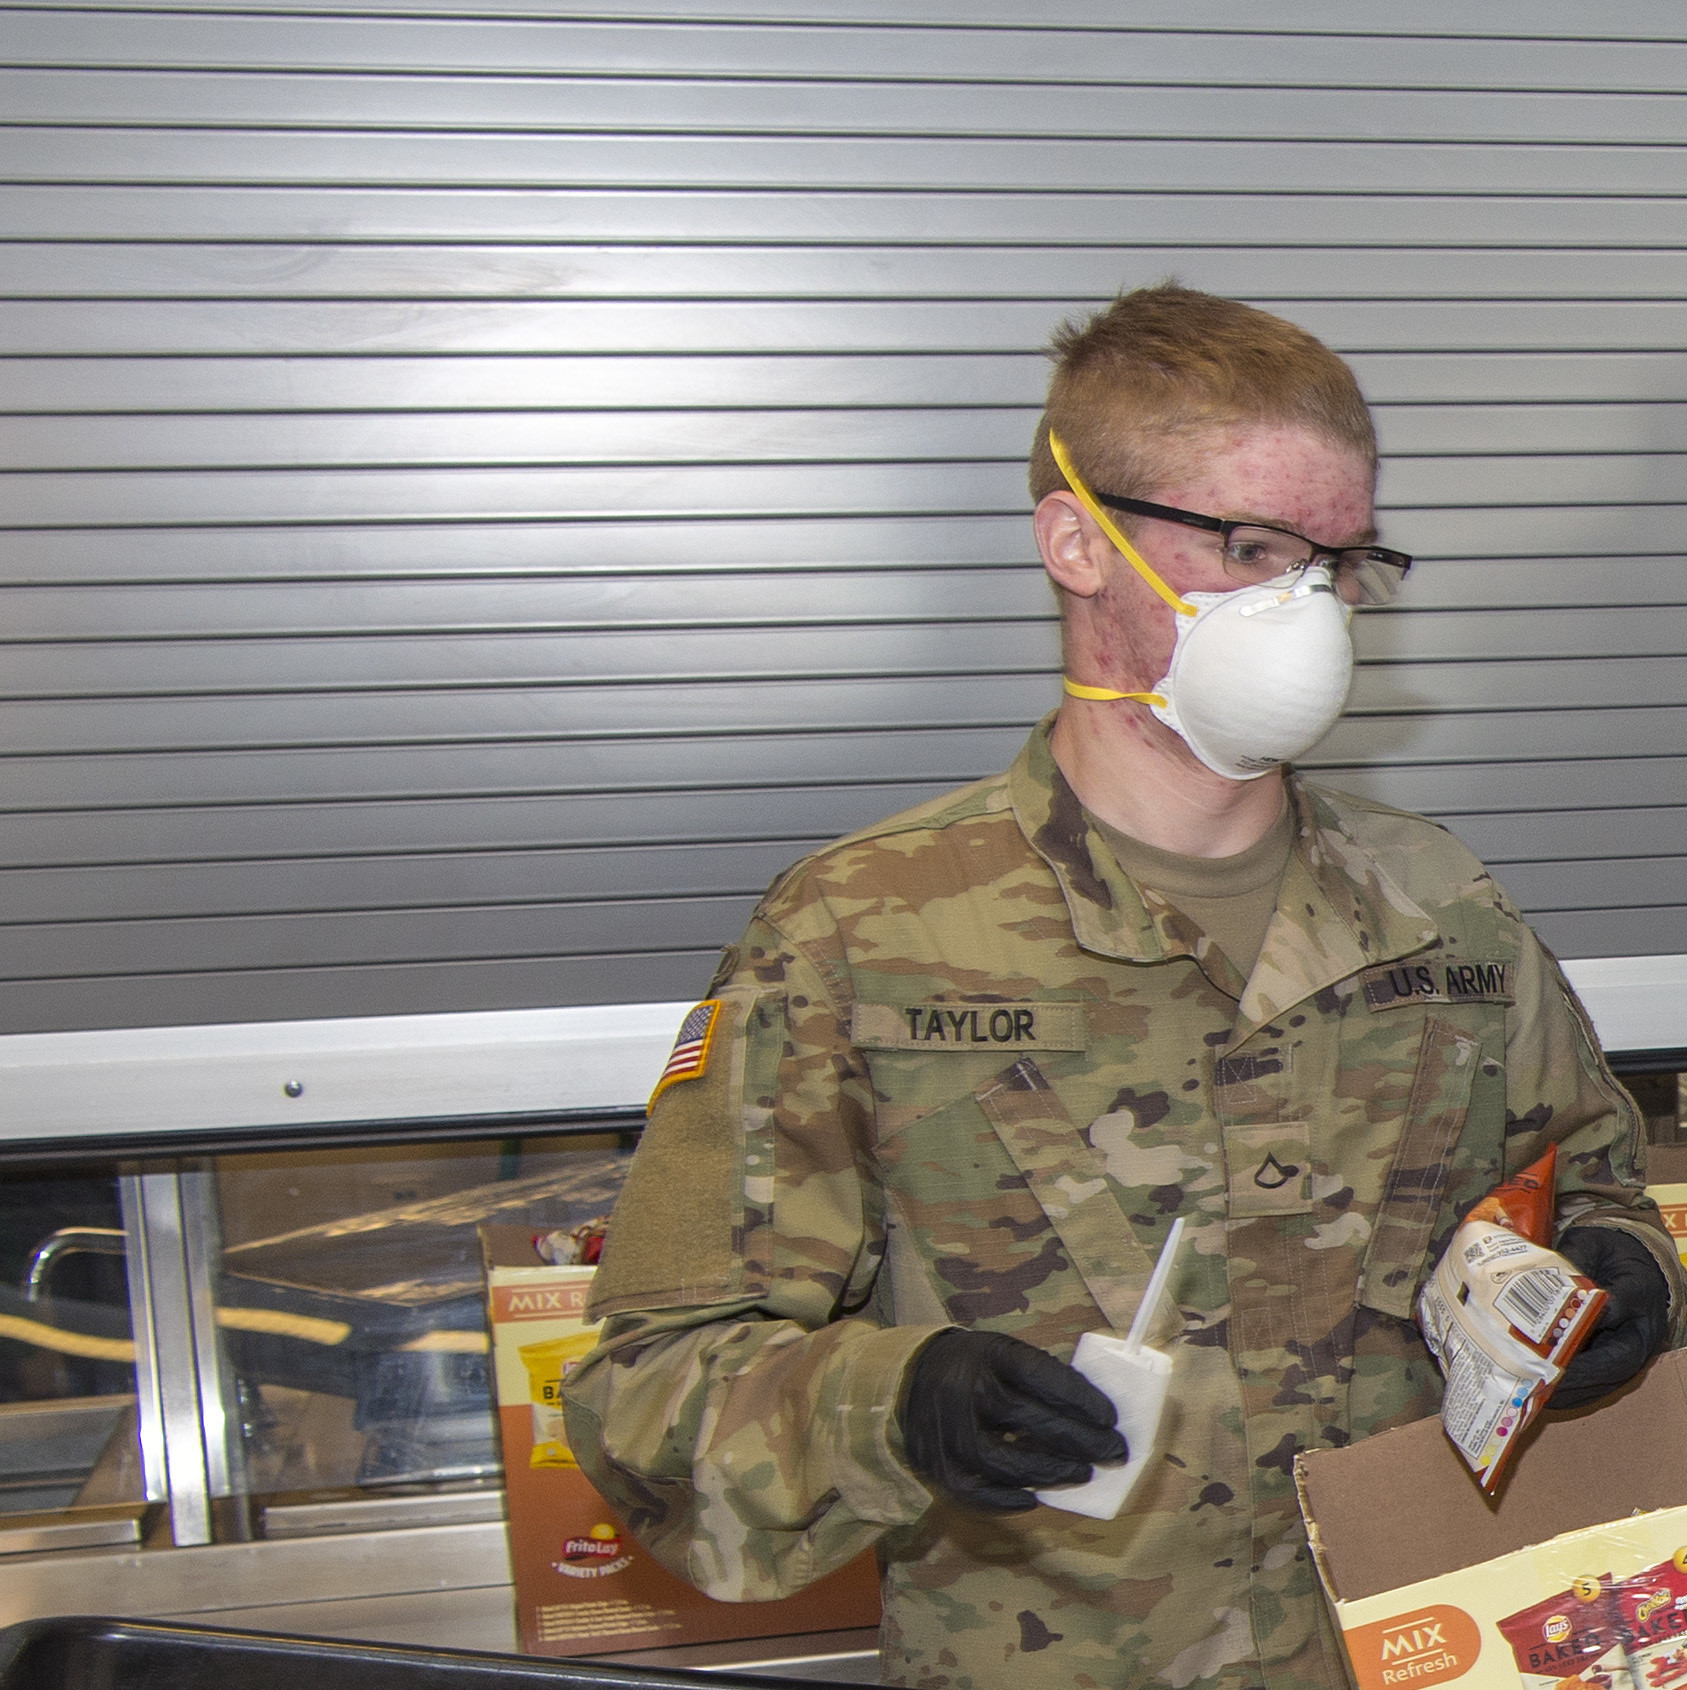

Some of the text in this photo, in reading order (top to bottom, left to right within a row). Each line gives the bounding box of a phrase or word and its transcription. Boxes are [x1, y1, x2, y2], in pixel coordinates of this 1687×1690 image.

[1388, 964, 1506, 997] U.S. ARMY
[904, 1008, 1036, 1042] TAYLOR
[508, 1292, 562, 1312] MIX
[1582, 1582, 1592, 1596] 5
[1382, 1622, 1448, 1662] MIX
[1528, 1632, 1600, 1670] BAKED
[1382, 1652, 1458, 1686] Refresh
